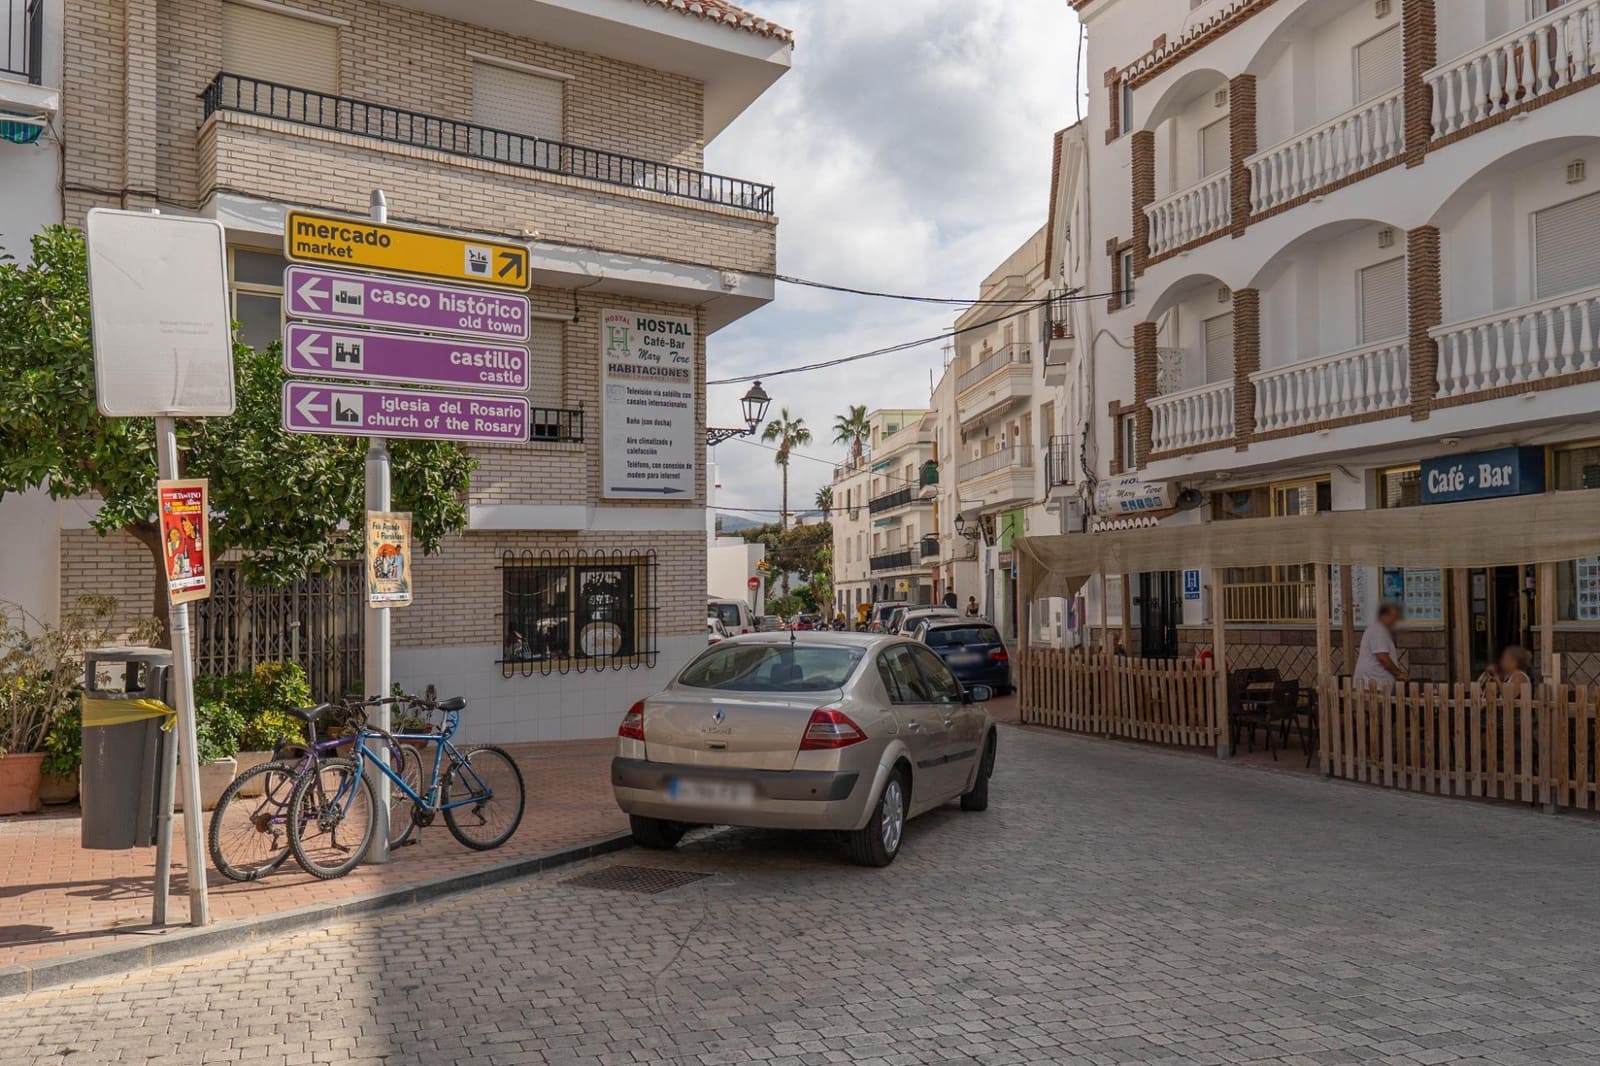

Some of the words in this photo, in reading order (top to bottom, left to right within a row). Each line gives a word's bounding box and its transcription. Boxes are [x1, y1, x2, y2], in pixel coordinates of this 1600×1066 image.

[297, 221, 390, 248] mercado
[297, 240, 352, 258] market
[370, 288, 430, 308] casco
[439, 293, 522, 319] histórico
[458, 316, 482, 329] old
[487, 319, 522, 334] town
[605, 315, 630, 326] HOSTAL
[636, 318, 692, 336] HOSTAL
[644, 336, 686, 349] Café-Bar
[450, 351, 522, 370] castillo
[638, 348, 662, 364] Mary
[670, 352, 690, 364] Tere
[480, 370, 522, 384] castle
[608, 364, 688, 378] HABITACIONES
[626, 387, 652, 396] Televisión
[381, 396, 430, 414] iglesia
[439, 400, 462, 415] del
[470, 402, 522, 418] Rosario
[648, 399, 687, 408] internacionales
[368, 414, 418, 428] church
[424, 416, 440, 429] of
[446, 417, 469, 430] the
[475, 418, 522, 436] Rosary
[654, 419, 672, 428] ducha)
[639, 437, 668, 446] climatizado
[1428, 464, 1464, 494] Café
[1478, 464, 1512, 488] Bar
